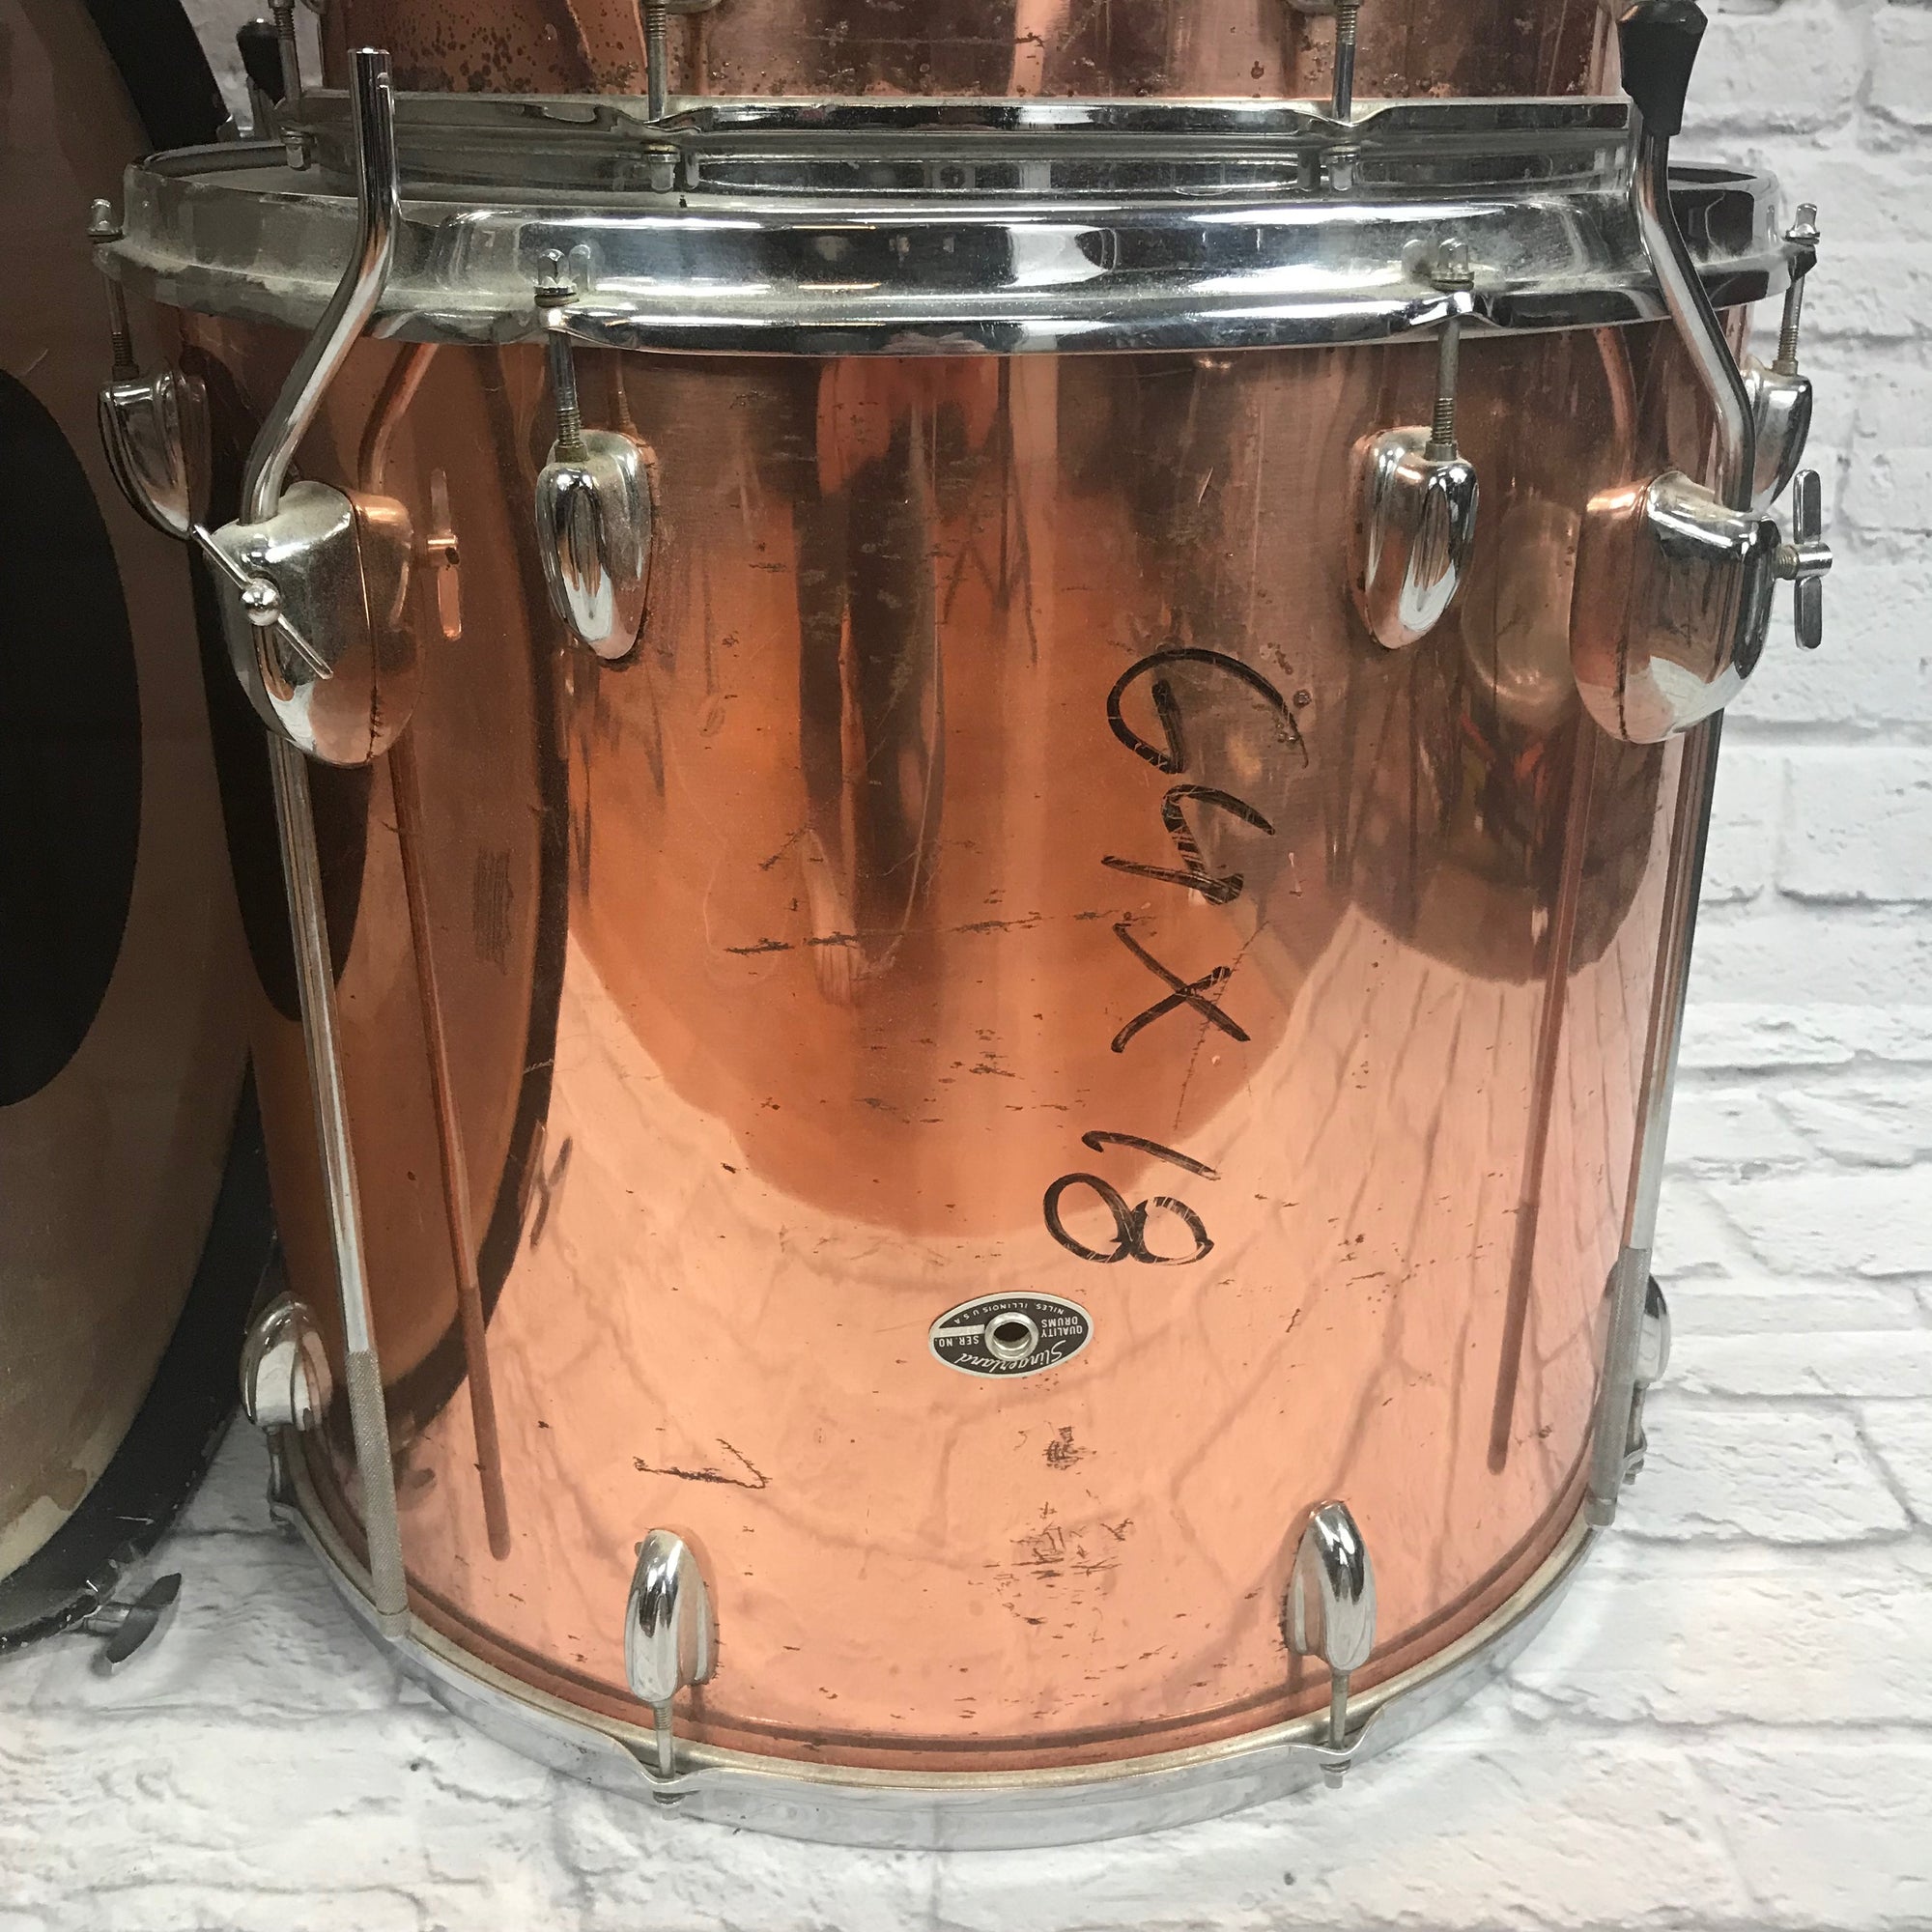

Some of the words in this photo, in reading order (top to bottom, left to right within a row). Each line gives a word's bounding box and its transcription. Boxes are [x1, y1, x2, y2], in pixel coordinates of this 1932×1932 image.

[982, 1303, 1028, 1314] ILLINOIS
[1041, 1317, 1078, 1327] DRUMS
[1041, 1325, 1083, 1337] QUALITY
[954, 1340, 1066, 1372] Slingerland
